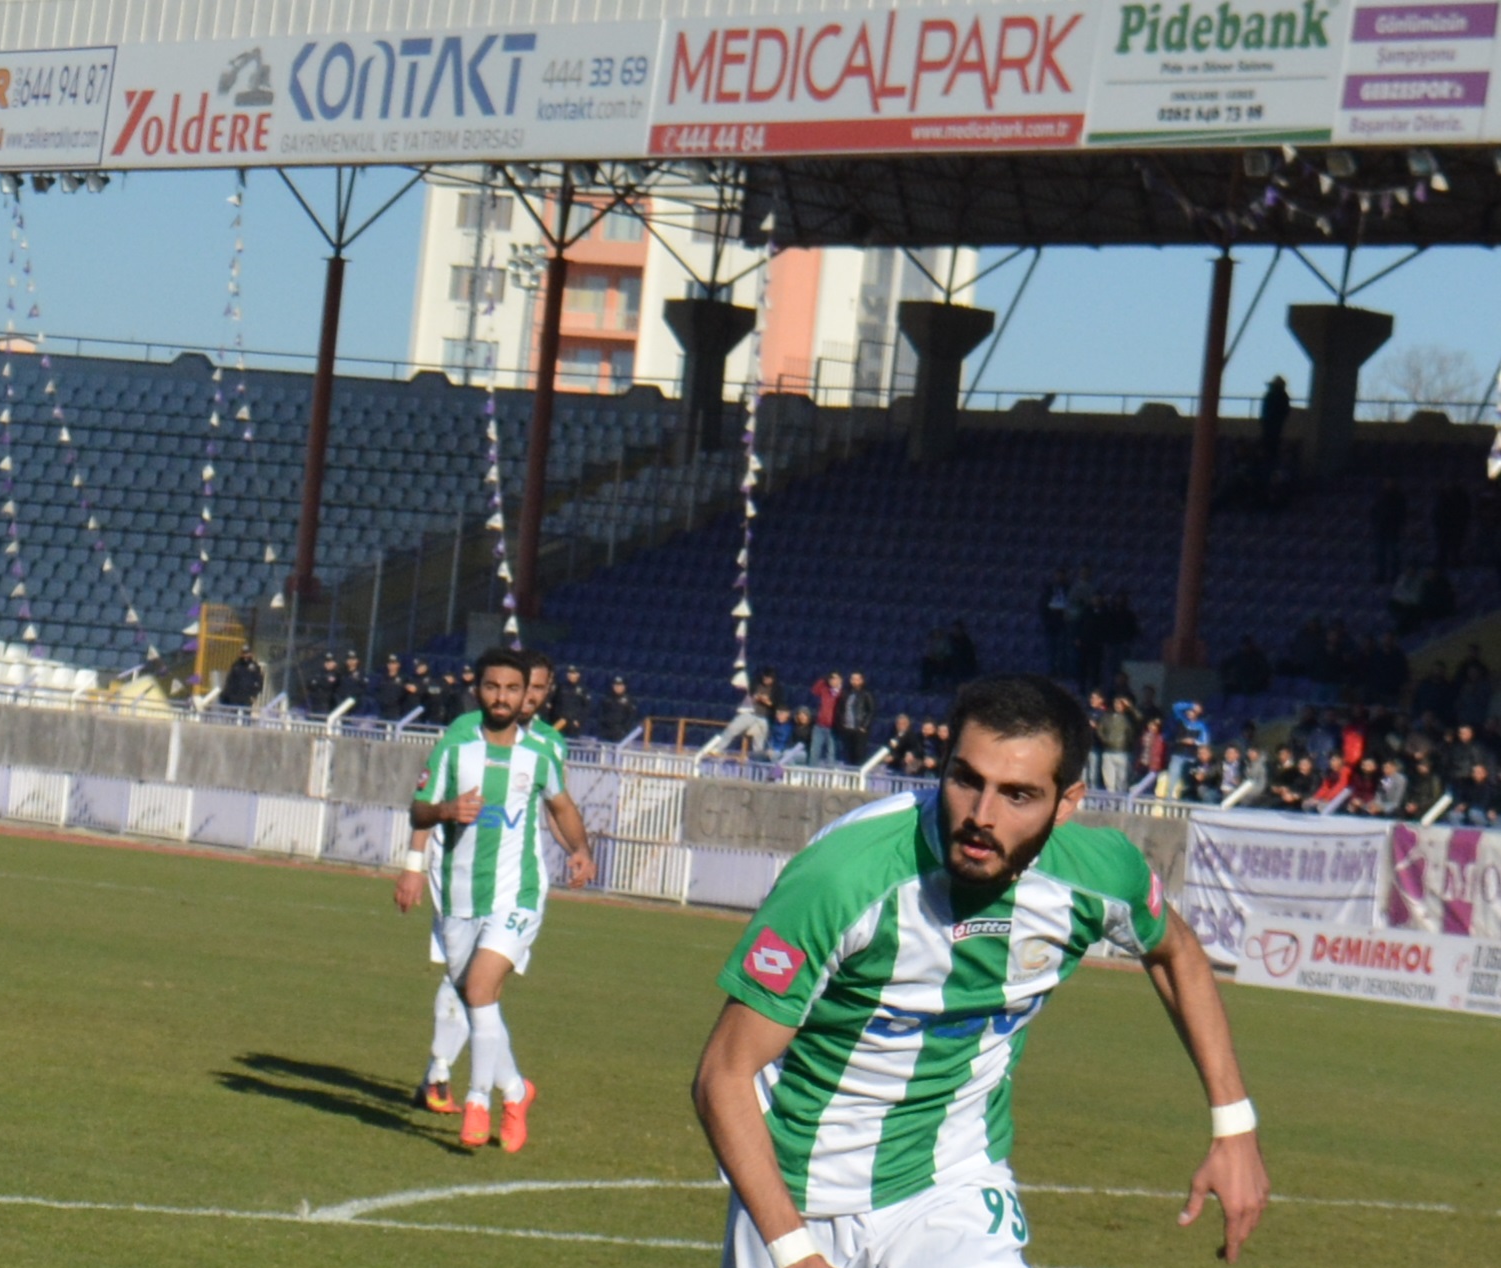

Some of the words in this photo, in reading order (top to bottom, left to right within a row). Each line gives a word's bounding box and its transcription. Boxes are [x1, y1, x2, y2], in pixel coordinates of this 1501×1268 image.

[1115, 1, 1329, 54] Pidebank
[20, 66, 53, 107] 644
[59, 64, 81, 105] 94
[85, 64, 108, 104] 87
[542, 59, 583, 89] 444
[588, 57, 613, 87] 33
[621, 56, 649, 86] 69
[537, 95, 643, 122] kontakt.com.tr
[280, 129, 376, 154] GAYRİMENKUL
[382, 131, 400, 152] VE
[403, 130, 459, 151] YATIRIM
[462, 128, 526, 150] BORSASI
[676, 126, 711, 152] 444
[714, 125, 738, 151] 44
[741, 125, 766, 151] 84
[911, 120, 1070, 142] www.medicalpark.com.tr
[505, 911, 528, 937] 54
[966, 920, 1011, 935] lotto
